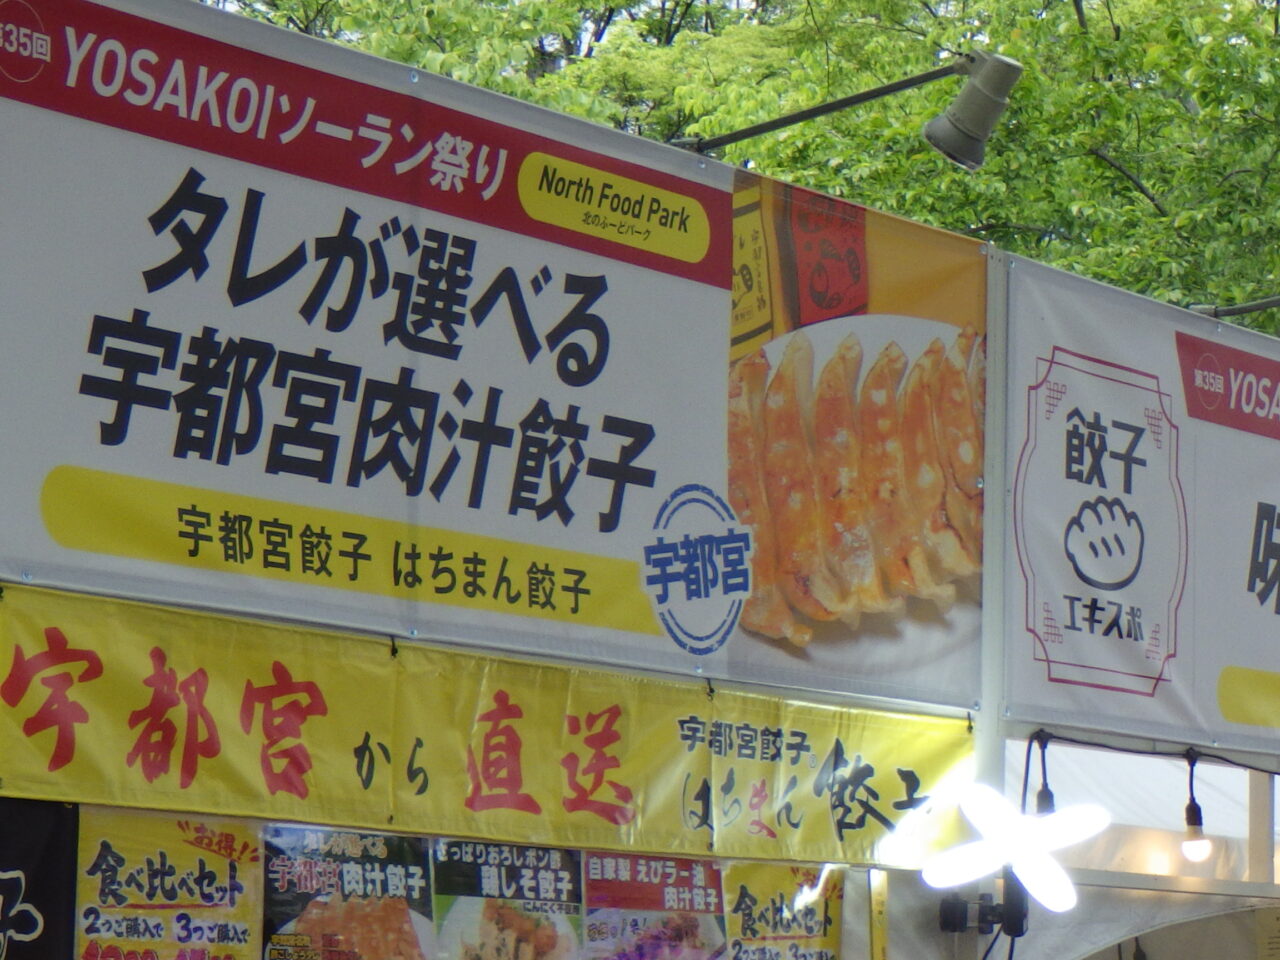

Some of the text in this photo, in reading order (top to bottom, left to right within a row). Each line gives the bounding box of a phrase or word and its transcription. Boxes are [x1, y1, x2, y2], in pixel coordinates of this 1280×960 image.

[64, 26, 510, 200] YOSAKOIソーラン祭り
[538, 164, 690, 234] North Food Park
[581, 210, 651, 242] 北のふーどパーク
[141, 166, 610, 387] タレが選べる
[78, 307, 658, 534] 宇都宮肉汁餃子
[1065, 406, 1148, 496] 餃子
[176, 503, 592, 615] 宇都宮餃子 はちまん餃子
[643, 529, 751, 606] 宇都宮
[1063, 593, 1146, 642] エキスポ
[677, 715, 812, 766] 宇都宮餃子
[85, 839, 245, 908] 食べ比べセット
[268, 855, 427, 899] 宇都宮肉汁餃子
